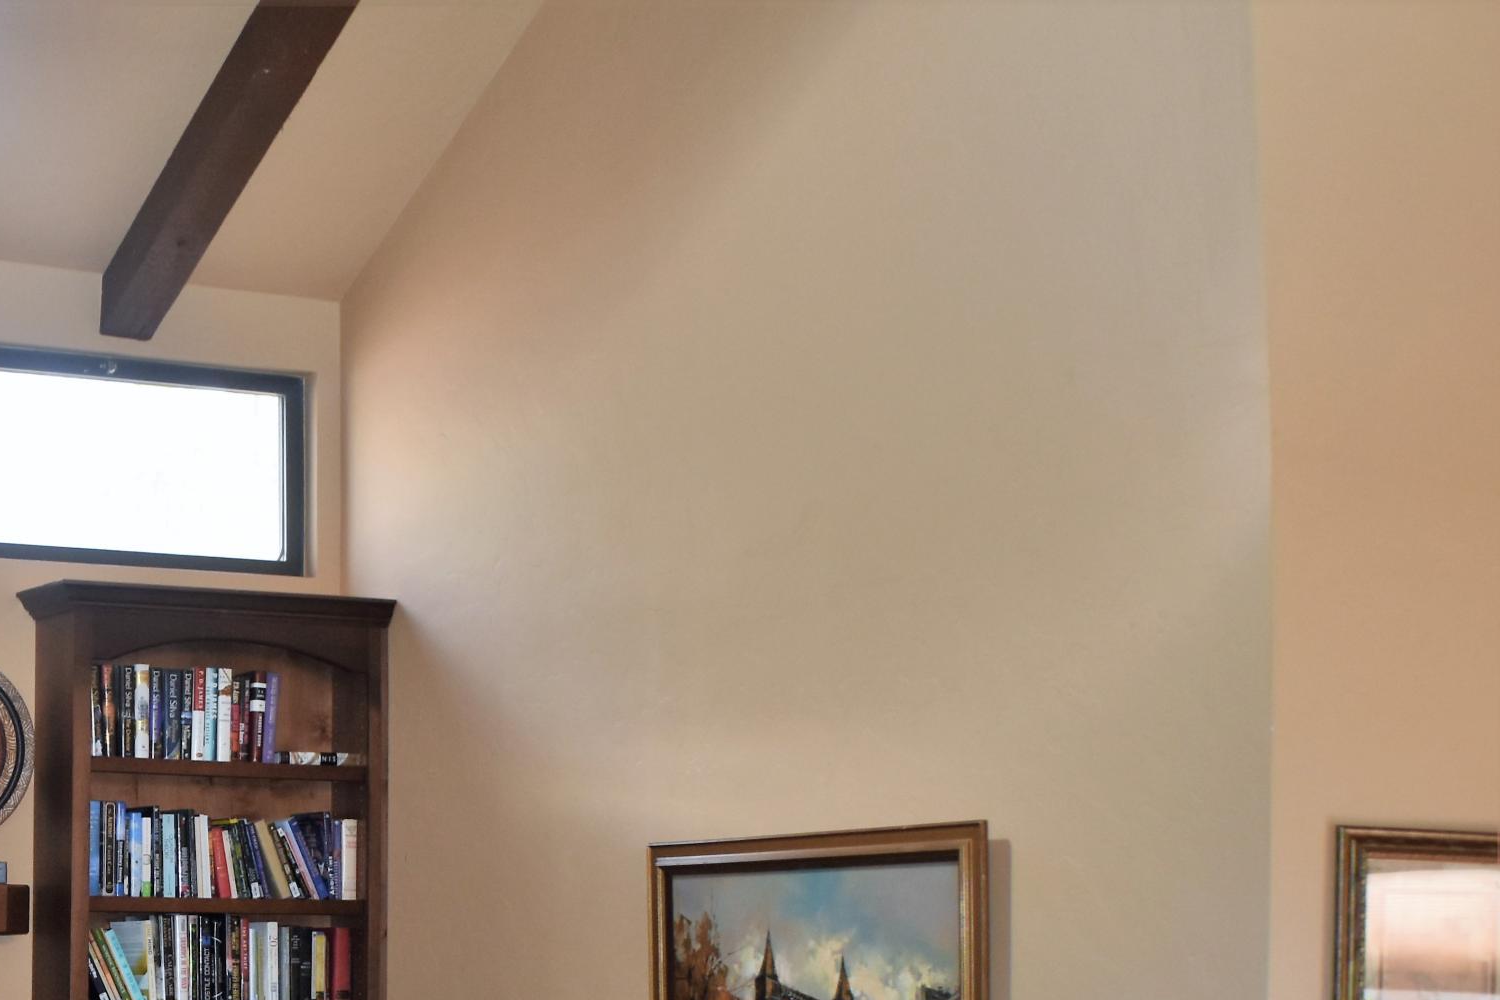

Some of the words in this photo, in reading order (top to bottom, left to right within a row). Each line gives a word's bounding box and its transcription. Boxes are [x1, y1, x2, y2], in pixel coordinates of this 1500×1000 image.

[125, 667, 133, 690] Daniel
[152, 670, 160, 692] Daniel
[169, 673, 179, 698] Daniel
[184, 673, 192, 695] Daniel
[125, 691, 133, 708] Silva
[152, 694, 160, 709] Silva
[169, 700, 179, 718] Silva
[203, 947, 211, 976] CONTACT
